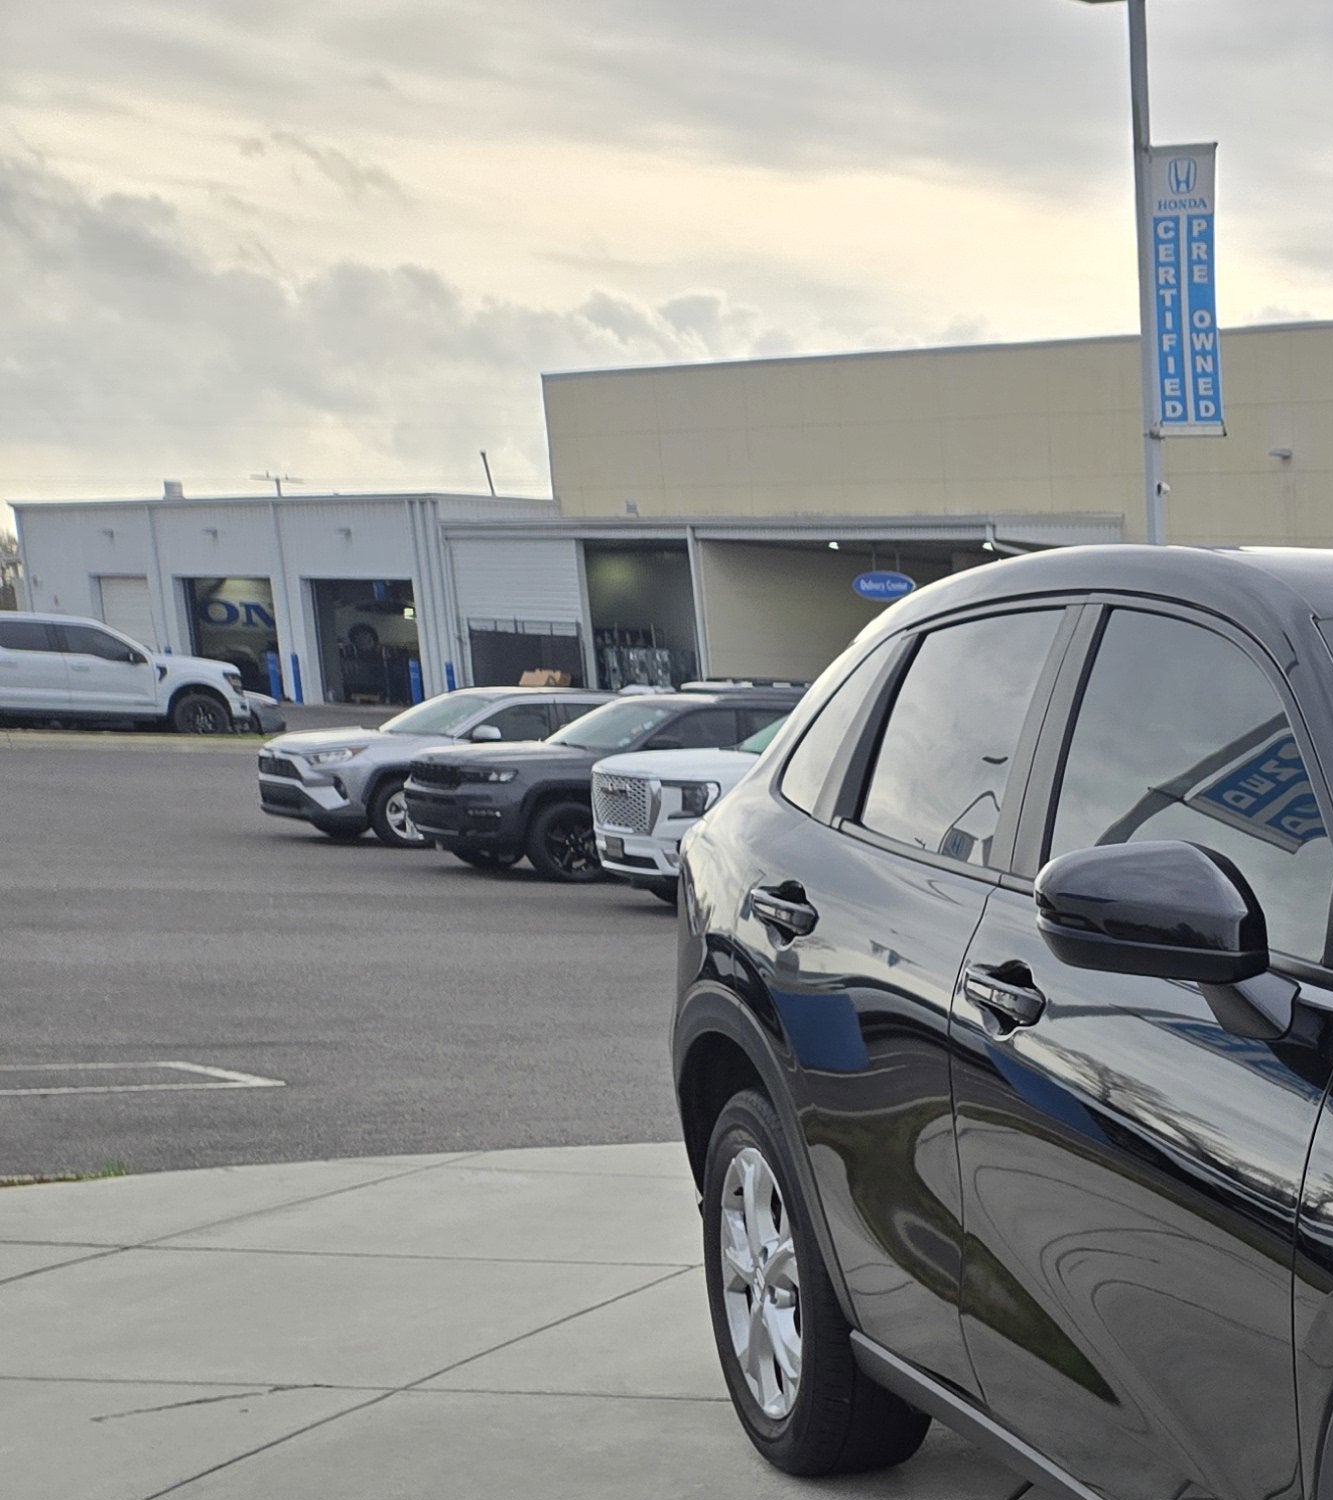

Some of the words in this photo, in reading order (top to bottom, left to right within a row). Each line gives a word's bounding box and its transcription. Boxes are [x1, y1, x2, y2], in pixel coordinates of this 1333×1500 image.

[1157, 197, 1208, 211] HONDA
[1191, 220, 1209, 284] PRE
[1156, 220, 1184, 418] CERTIFIED
[1191, 309, 1216, 418] OWNED
